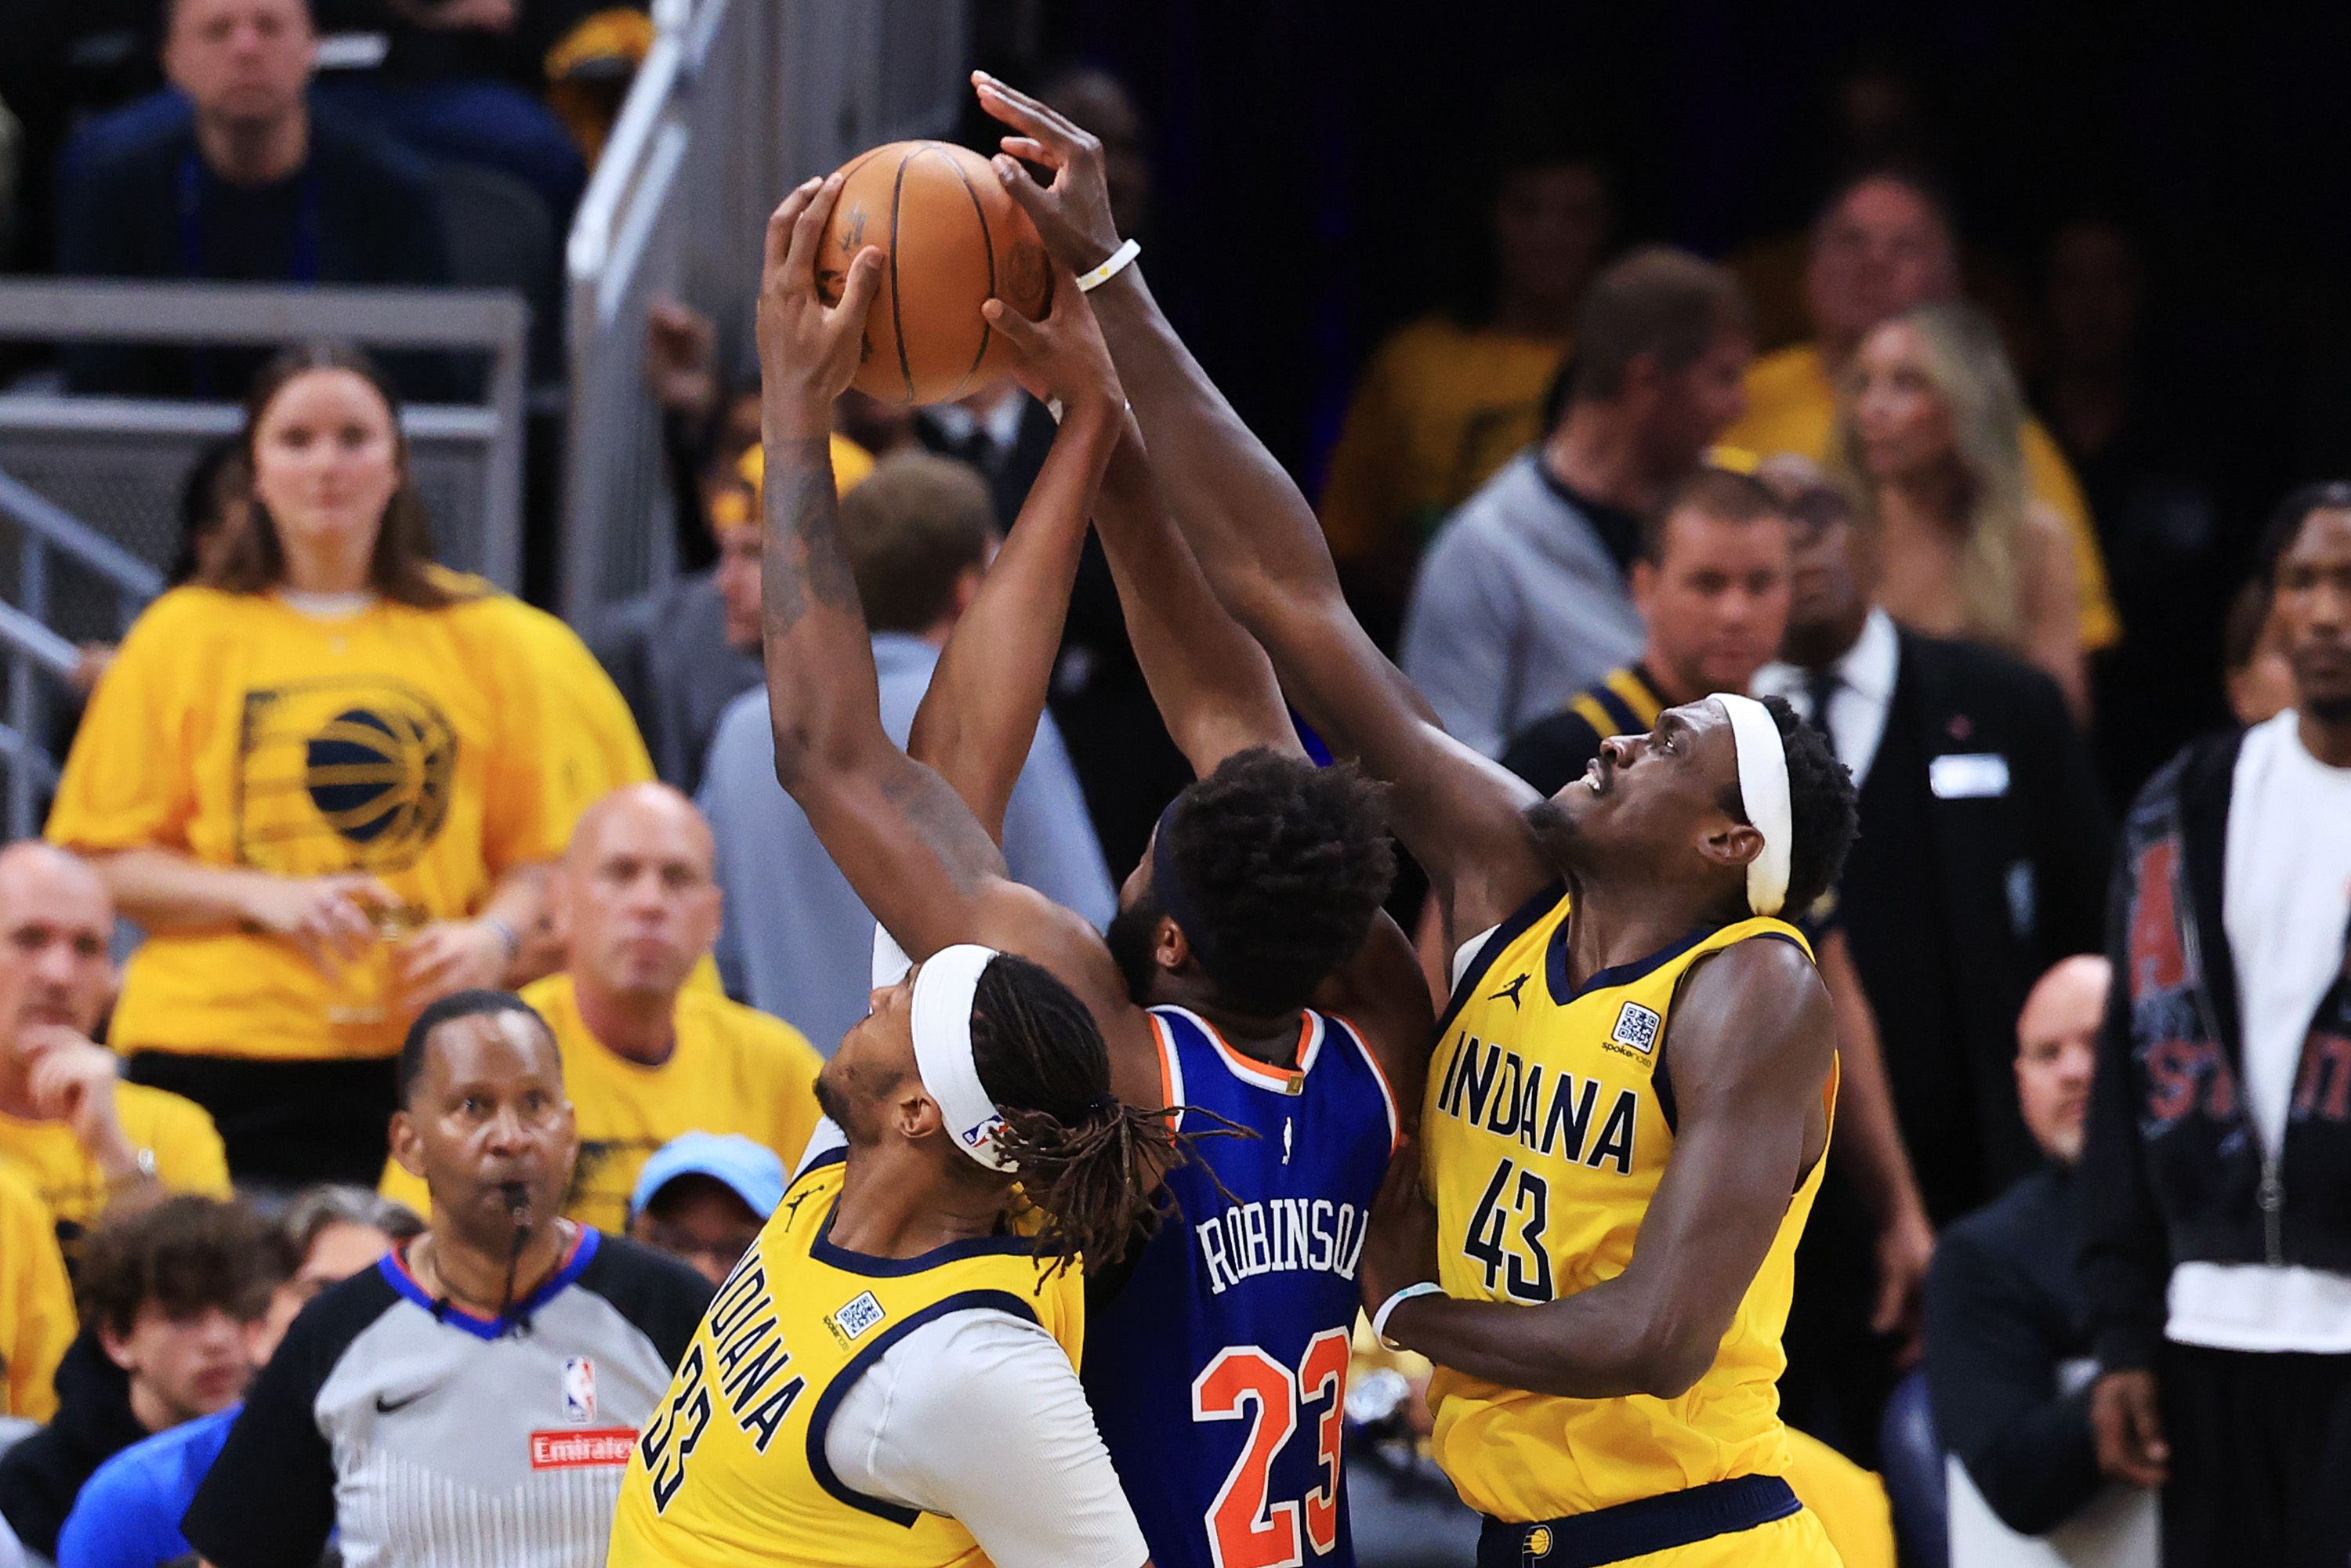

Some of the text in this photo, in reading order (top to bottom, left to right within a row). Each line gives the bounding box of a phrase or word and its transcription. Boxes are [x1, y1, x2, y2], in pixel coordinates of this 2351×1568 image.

[1437, 1030, 1638, 1176] INDANA
[1463, 1157, 1556, 1303] 43
[640, 1341, 712, 1517] 33
[1191, 1325, 1353, 1568] 23
